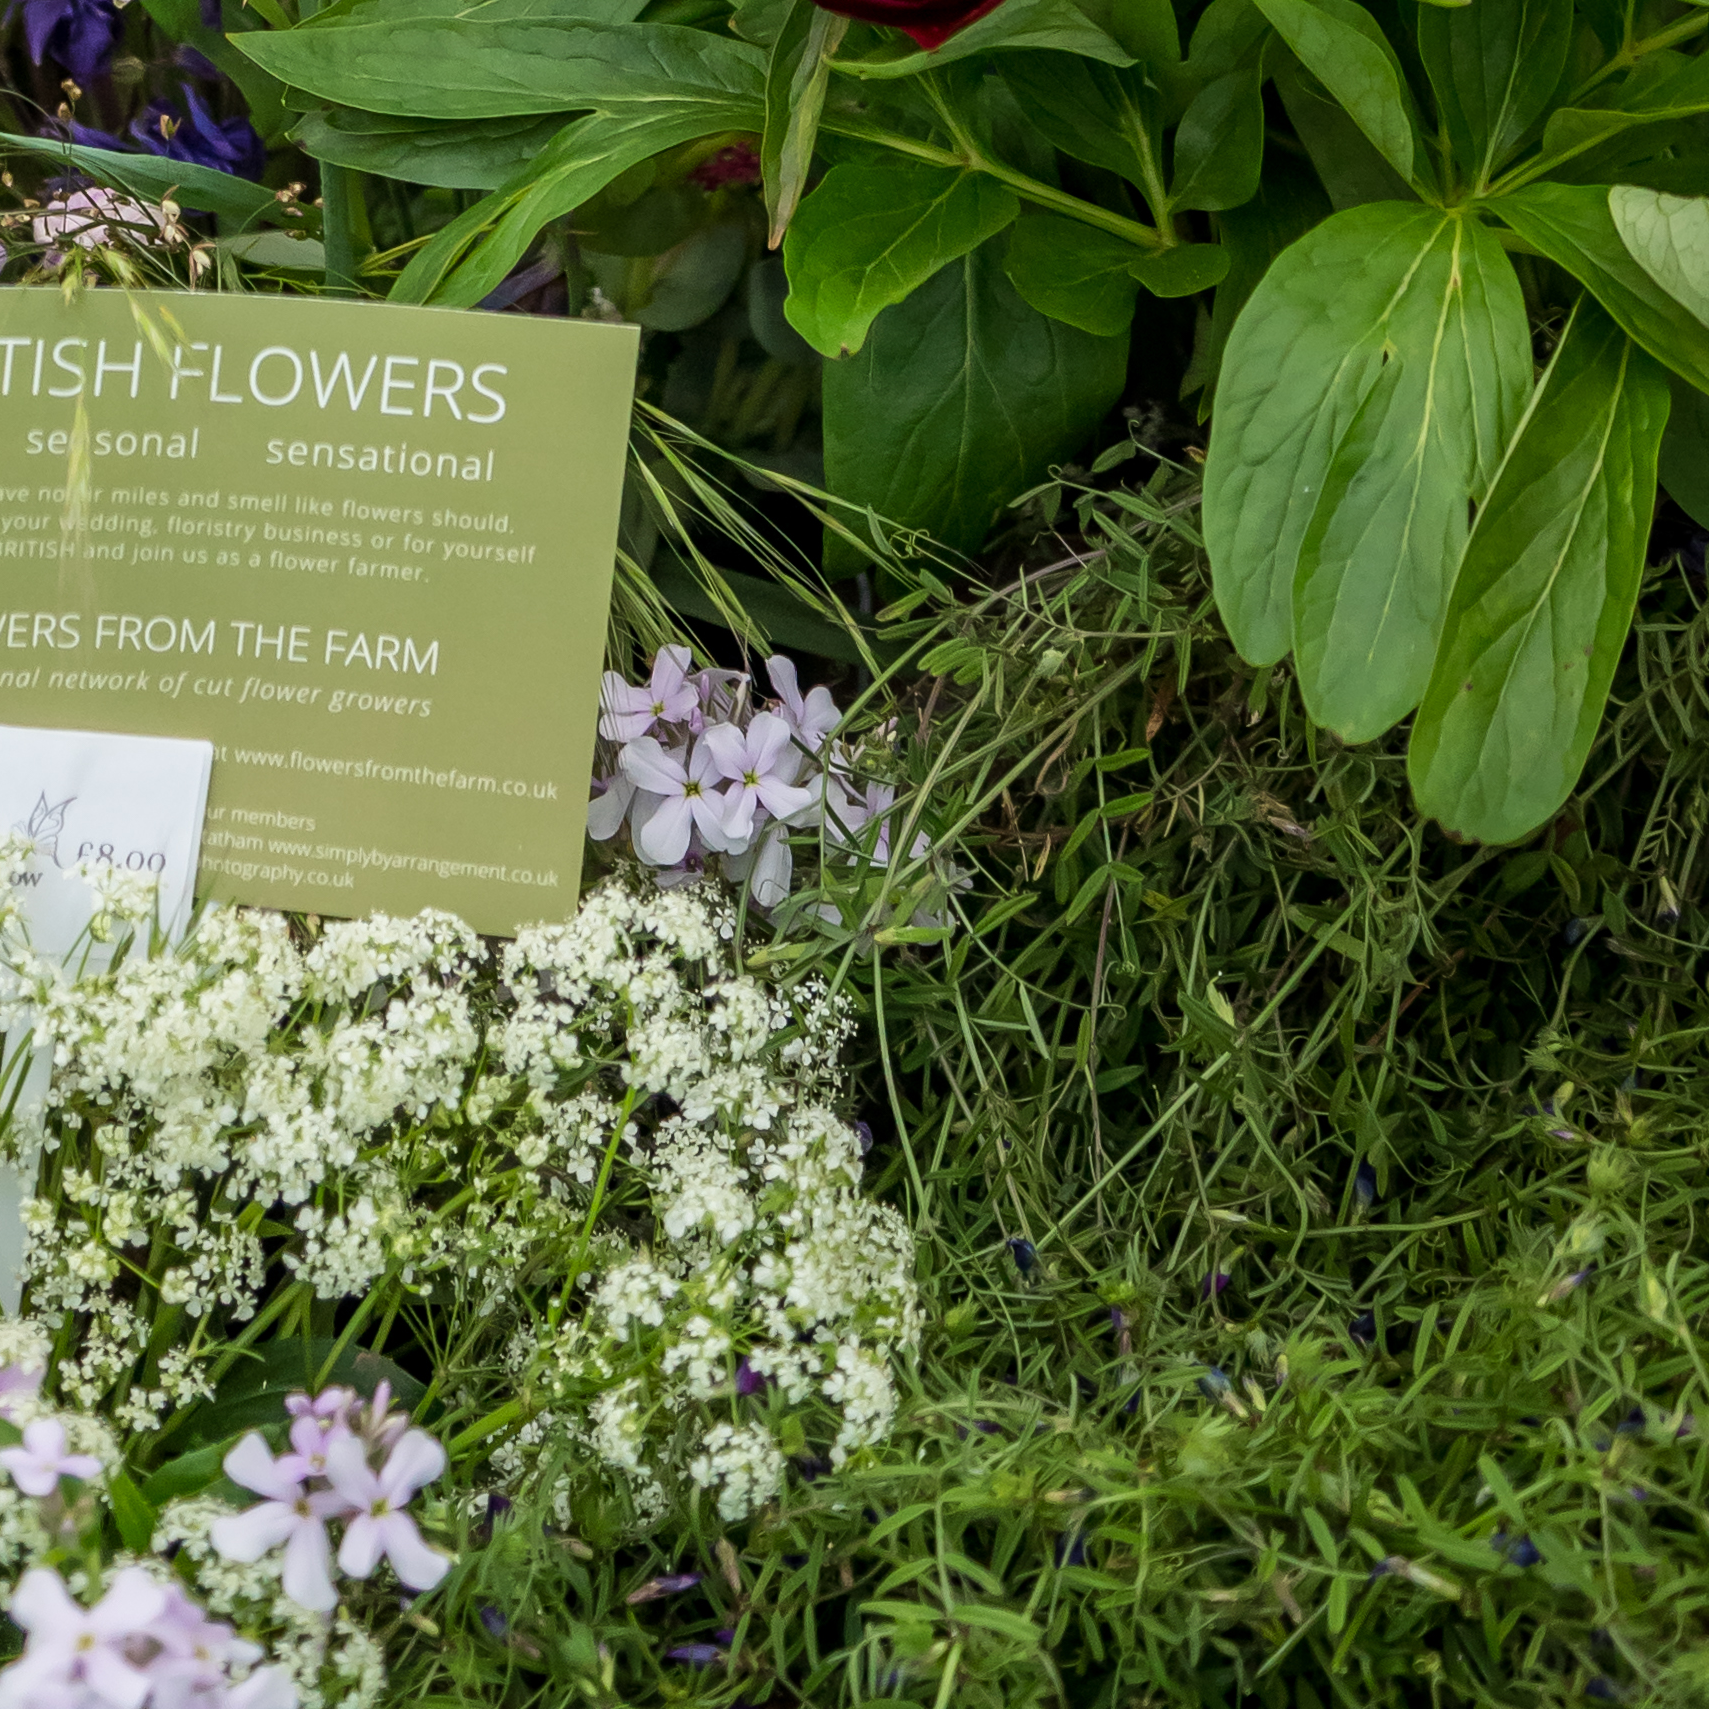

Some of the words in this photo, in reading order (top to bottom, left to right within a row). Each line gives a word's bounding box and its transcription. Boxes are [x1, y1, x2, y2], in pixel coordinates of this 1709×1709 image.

[169, 343, 508, 424] FLOWERS
[25, 426, 199, 459] sesonal
[265, 437, 495, 482] sensational
[38, 488, 66, 503] no
[111, 486, 170, 506] miles
[177, 489, 220, 508] and
[228, 493, 288, 513] smell
[295, 495, 334, 516] like
[342, 498, 424, 526] flowers
[432, 508, 514, 534] should.
[0, 514, 51, 534] your
[168, 515, 257, 544] floristry
[264, 522, 363, 548] business
[370, 533, 394, 550] or
[403, 533, 435, 554] for
[442, 541, 536, 564] yourself
[83, 542, 125, 560] and
[131, 543, 174, 565] join
[182, 548, 208, 565] us
[216, 551, 240, 567] as
[248, 553, 261, 568] a
[269, 550, 339, 573] flower
[348, 557, 429, 583] farmer.
[95, 615, 215, 655] FROM
[230, 620, 310, 663] THE
[324, 629, 439, 676] FARM
[47, 669, 148, 691] network
[158, 670, 189, 699] of
[192, 676, 234, 697] cut
[239, 676, 322, 704] flower
[327, 689, 432, 718] growers
[234, 748, 558, 800] www.flowersfromthefarm.co.uk
[231, 807, 317, 833] members
[76, 841, 166, 874] £8.00
